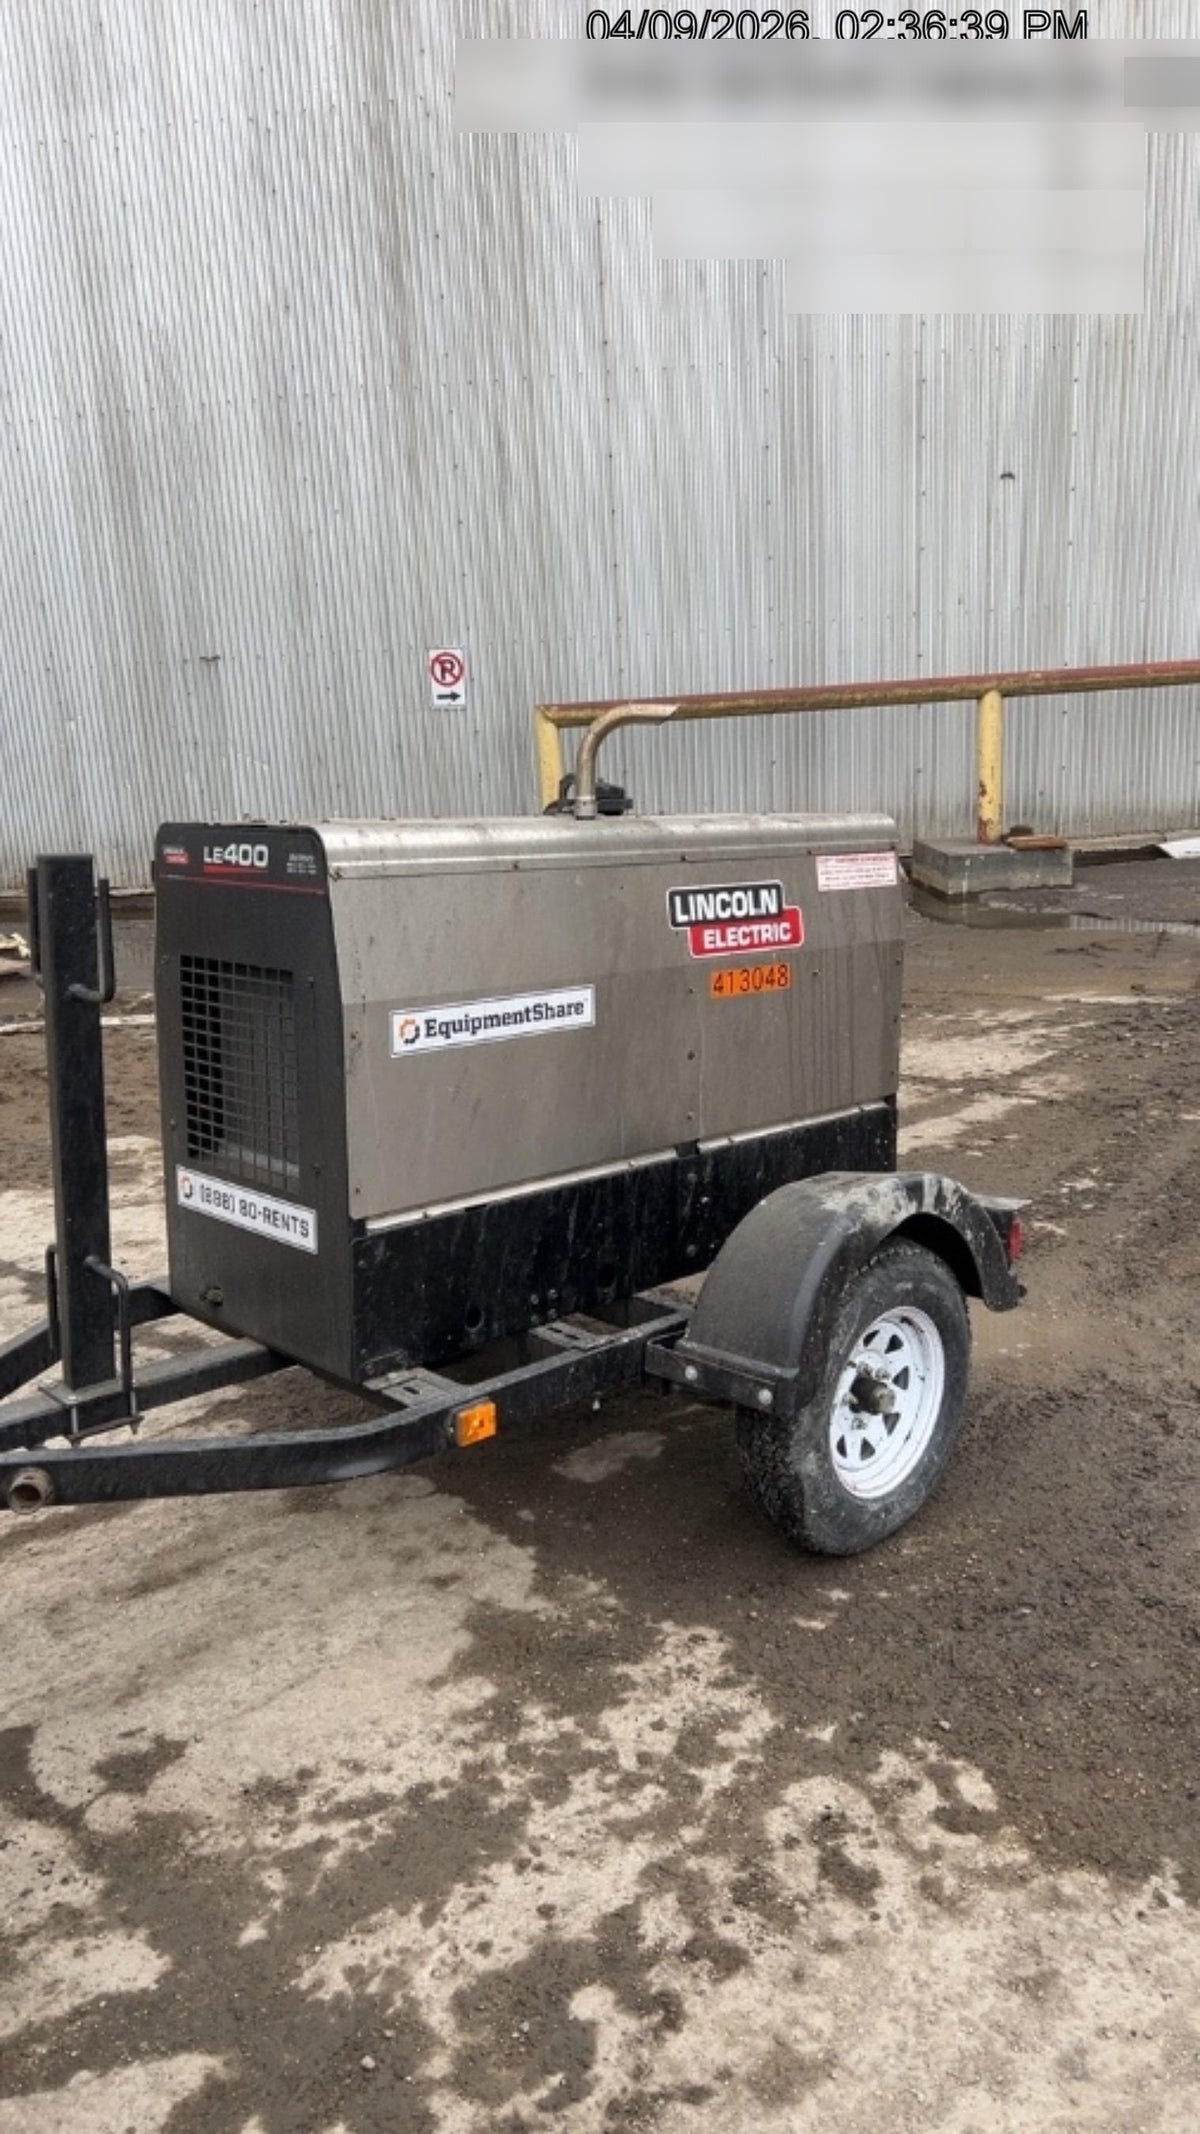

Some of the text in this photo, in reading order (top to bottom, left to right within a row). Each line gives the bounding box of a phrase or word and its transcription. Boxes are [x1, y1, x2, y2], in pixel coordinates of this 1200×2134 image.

[203, 844, 268, 867] LE400
[675, 889, 778, 922] LINCOLN
[704, 922, 792, 949] ELECTRIC
[712, 964, 789, 994] 413048
[425, 1001, 585, 1039] EquipmentShare
[239, 1198, 309, 1238] 80-RENTS
